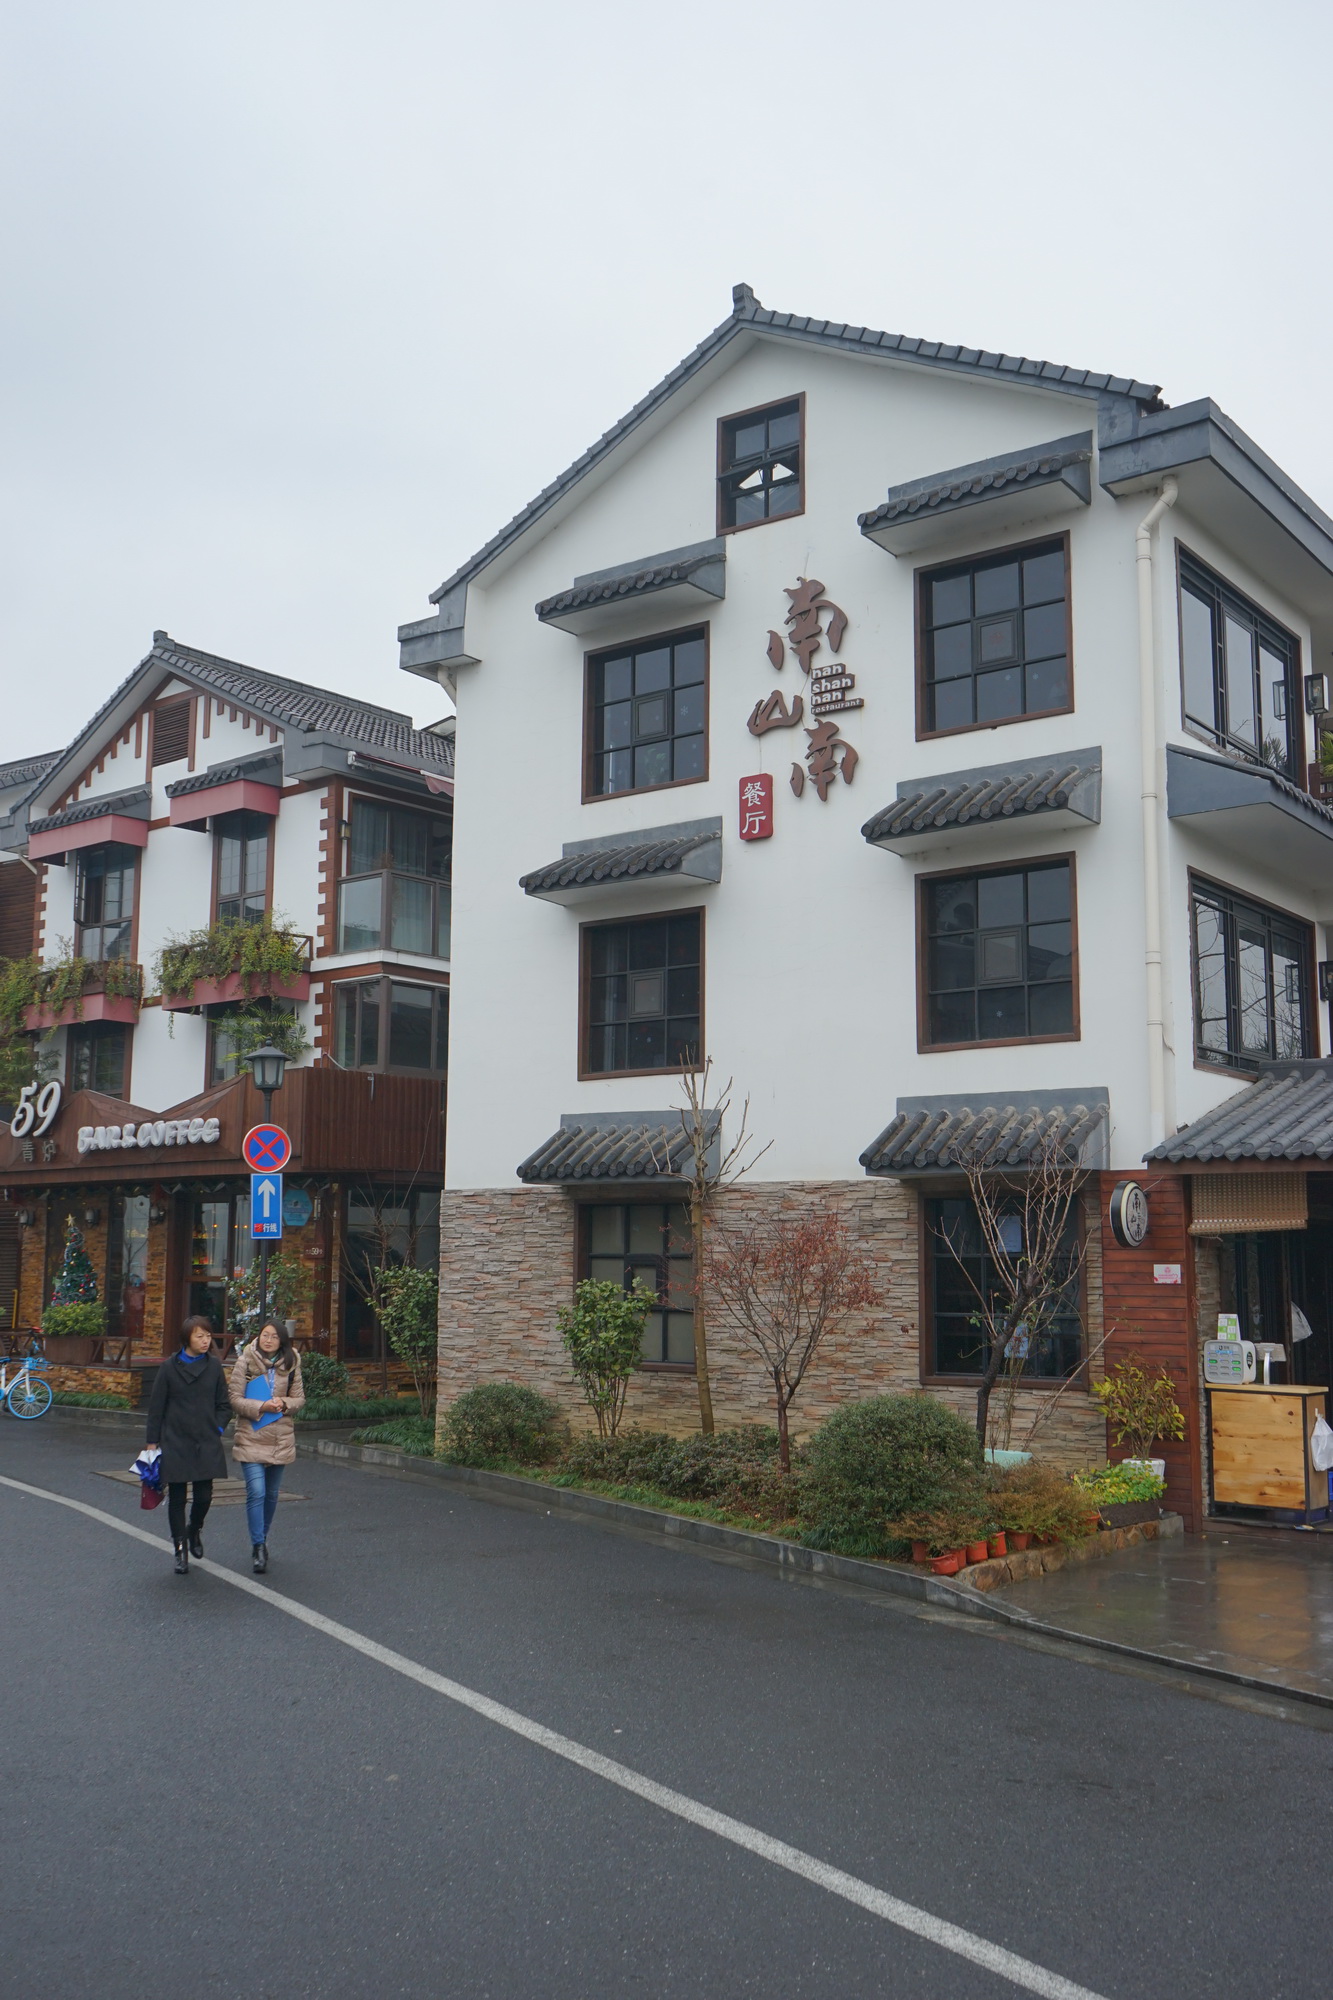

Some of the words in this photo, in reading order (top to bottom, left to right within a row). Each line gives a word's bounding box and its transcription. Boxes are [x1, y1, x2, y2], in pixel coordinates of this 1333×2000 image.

[812, 664, 842, 679] nan
[812, 678, 851, 693] shan
[811, 691, 842, 705] nan
[811, 699, 861, 714] restaurant
[741, 782, 767, 835] 餐厅
[10, 1081, 62, 1138] 59
[254, 1223, 277, 1233] 行线
